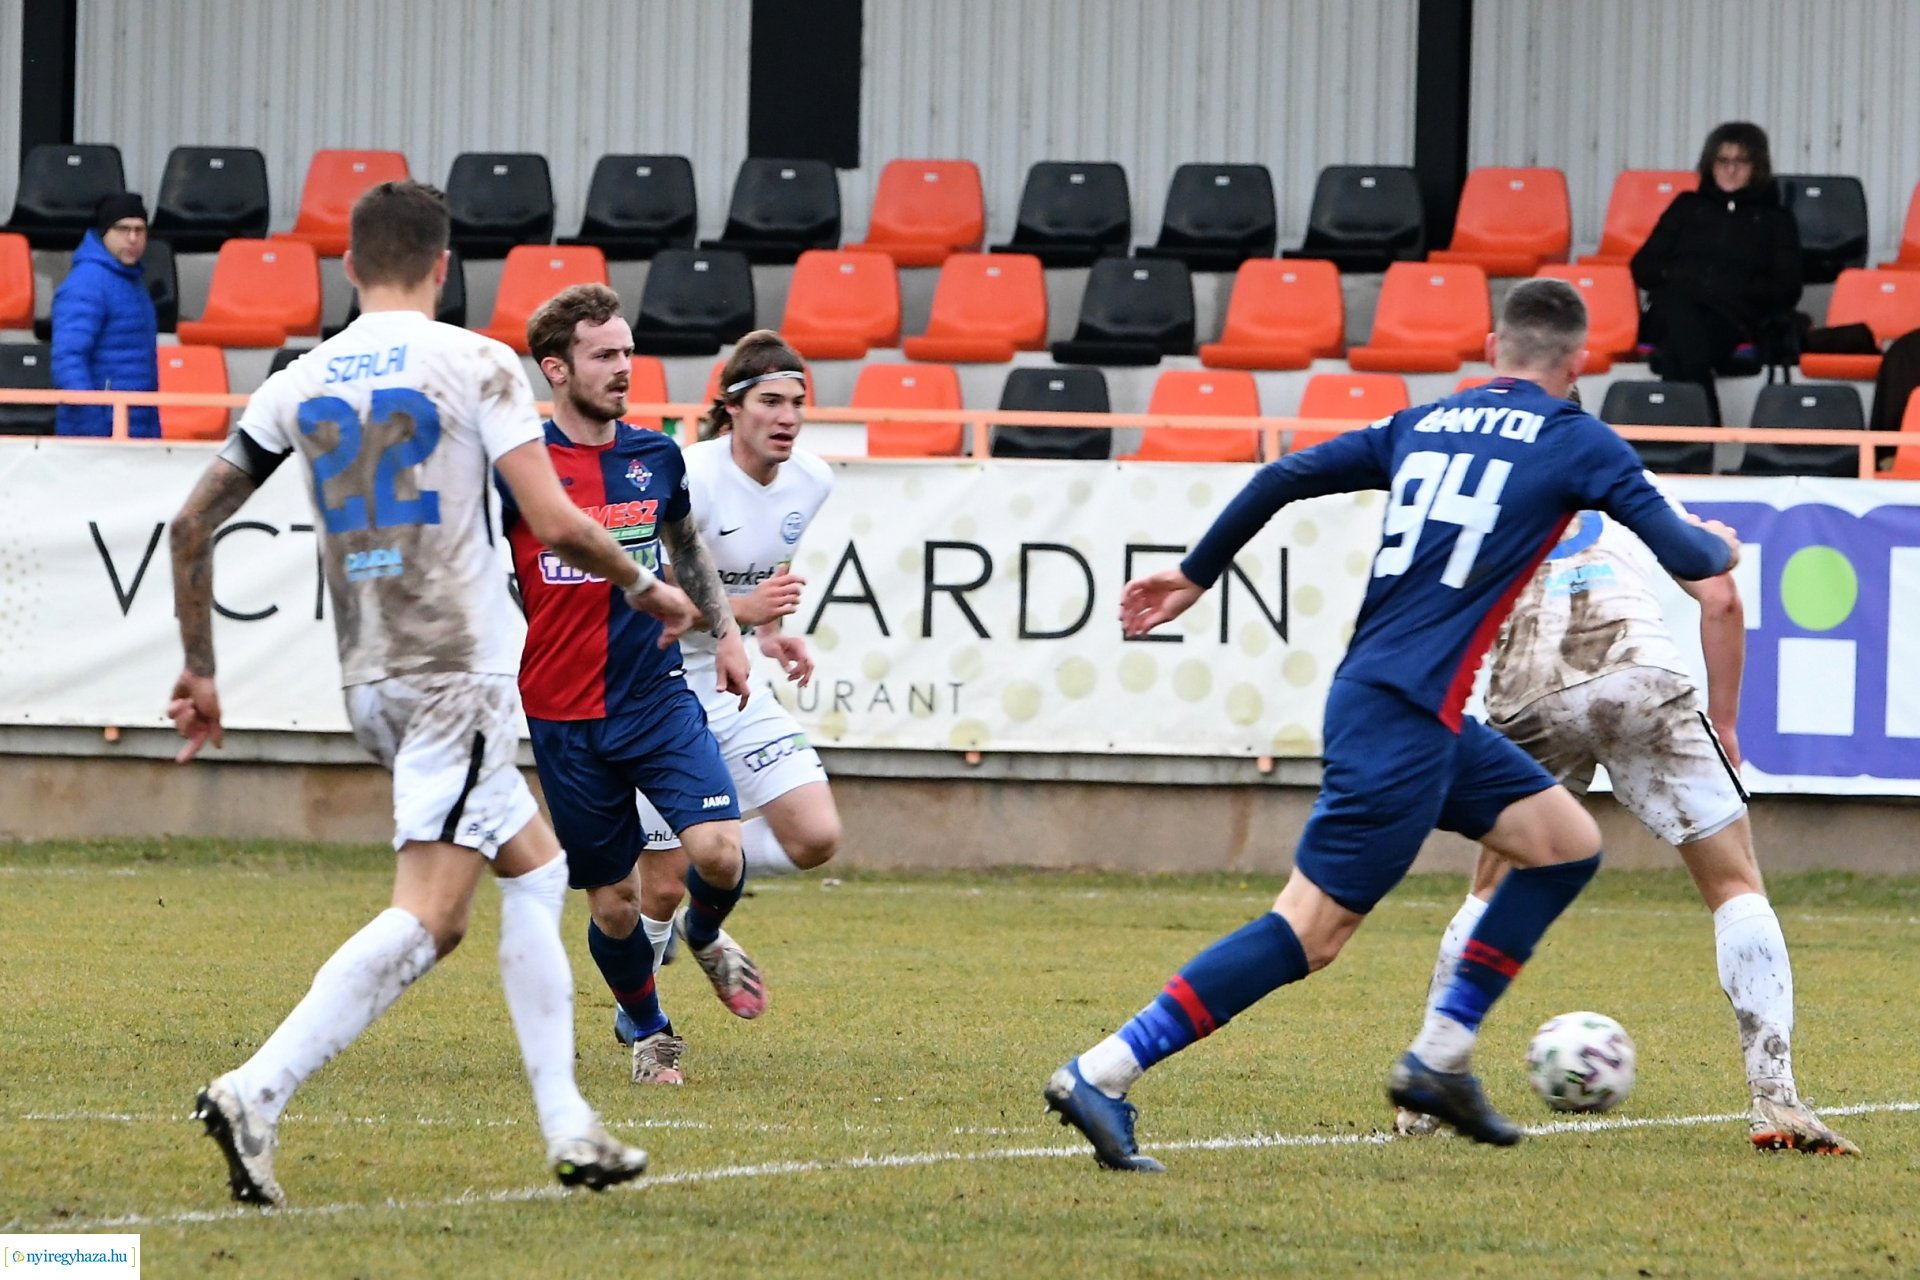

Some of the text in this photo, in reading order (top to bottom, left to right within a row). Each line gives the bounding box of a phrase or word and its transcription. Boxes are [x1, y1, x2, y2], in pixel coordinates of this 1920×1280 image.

[325, 345, 408, 384] SZALAI
[297, 387, 441, 534] 22
[1373, 450, 1514, 589] 94
[805, 540, 1288, 644] ARDEN
[702, 794, 731, 809] JAKO
